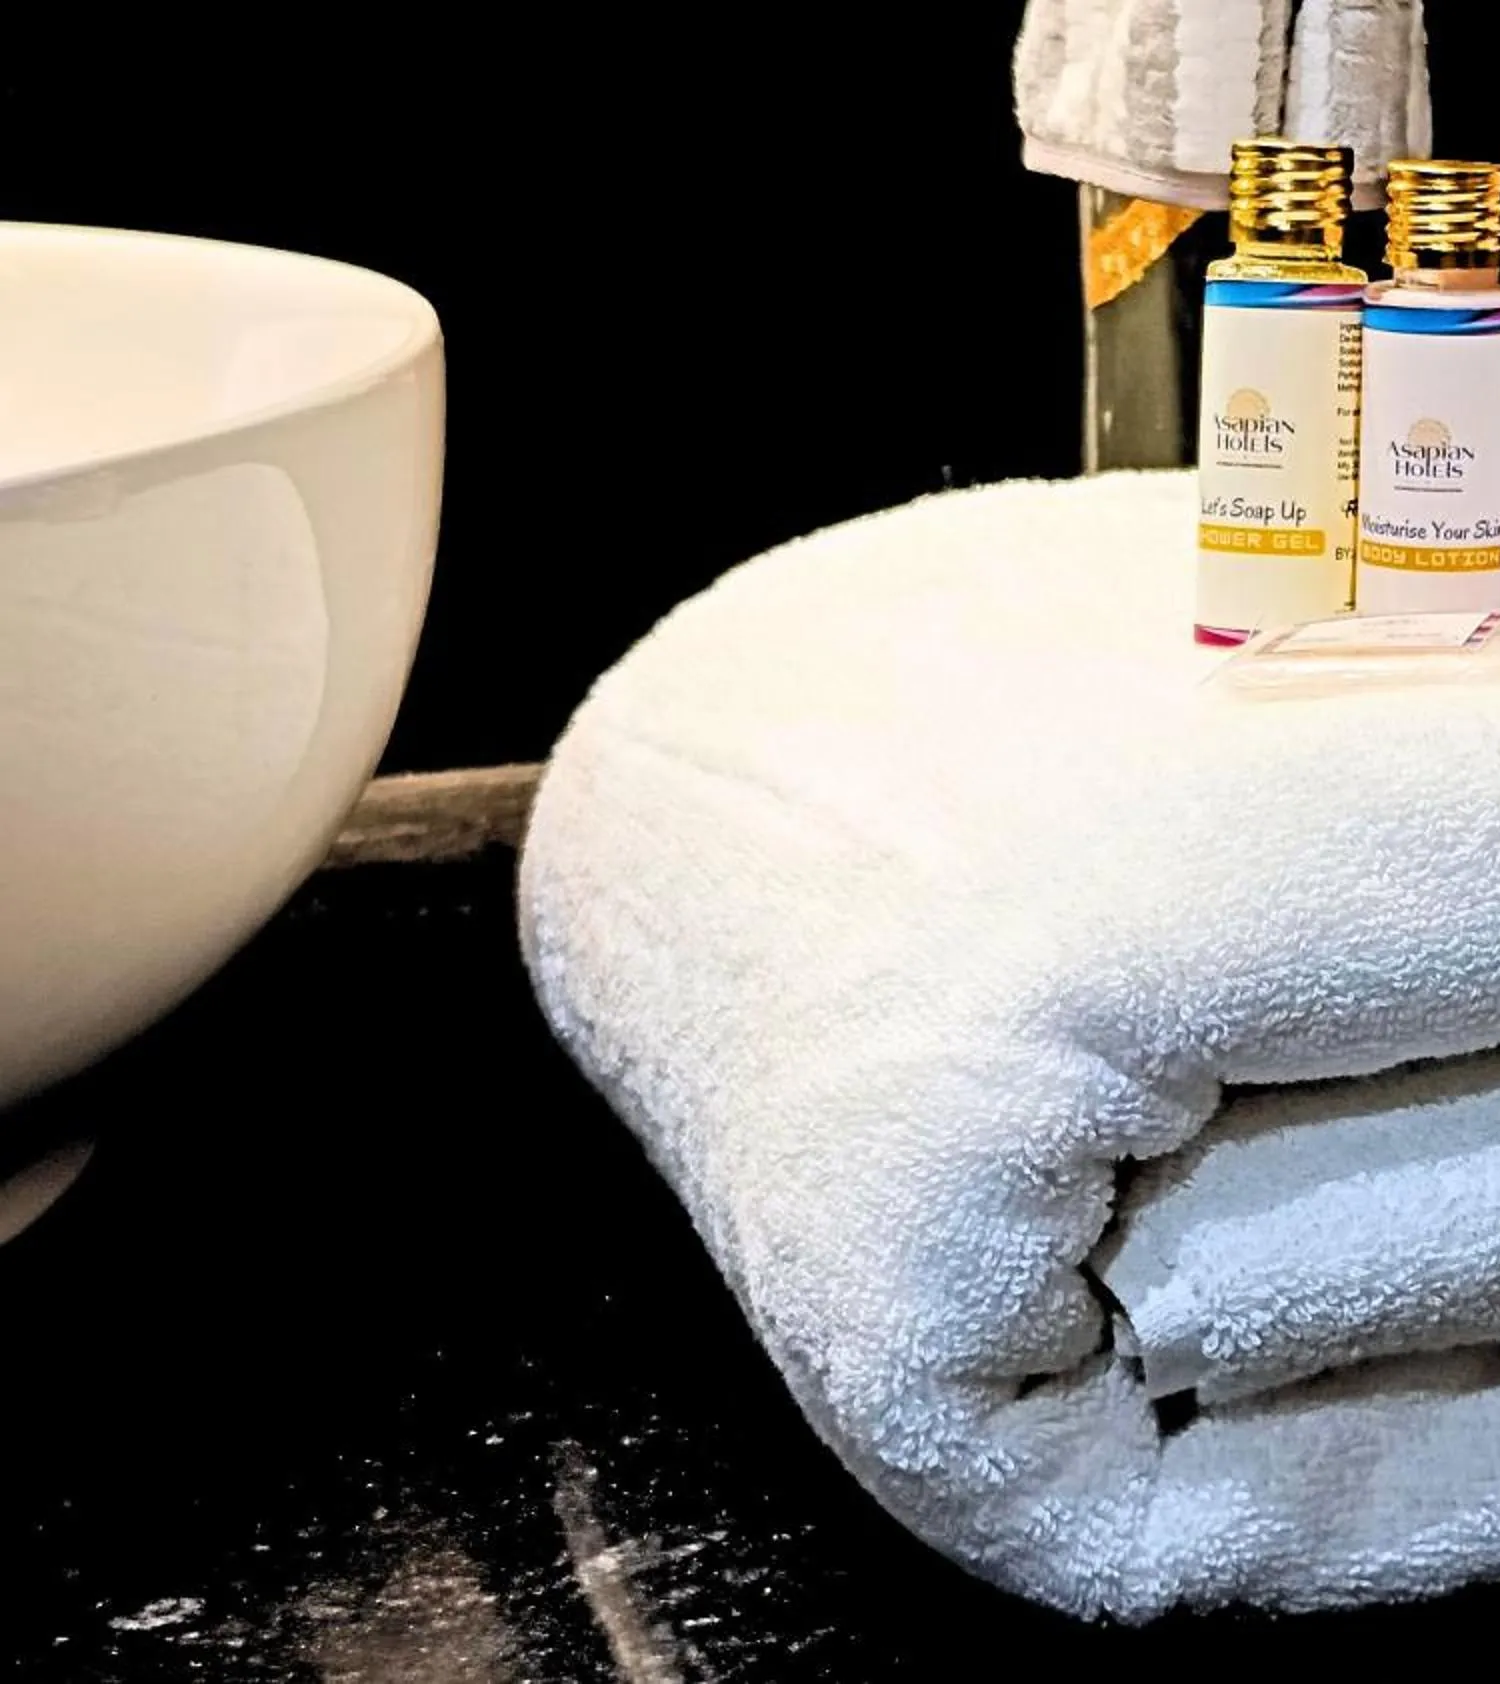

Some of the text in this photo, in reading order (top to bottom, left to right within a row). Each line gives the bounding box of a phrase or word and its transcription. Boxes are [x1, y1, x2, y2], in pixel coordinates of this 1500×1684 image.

[1389, 440, 1474, 462] Asapian
[1230, 497, 1275, 526] Soap
[1281, 500, 1307, 528] Up
[1362, 513, 1427, 539] Moisturise
[1431, 520, 1470, 540] Your
[1272, 533, 1320, 550] GEL
[1415, 550, 1499, 567] LOTION
